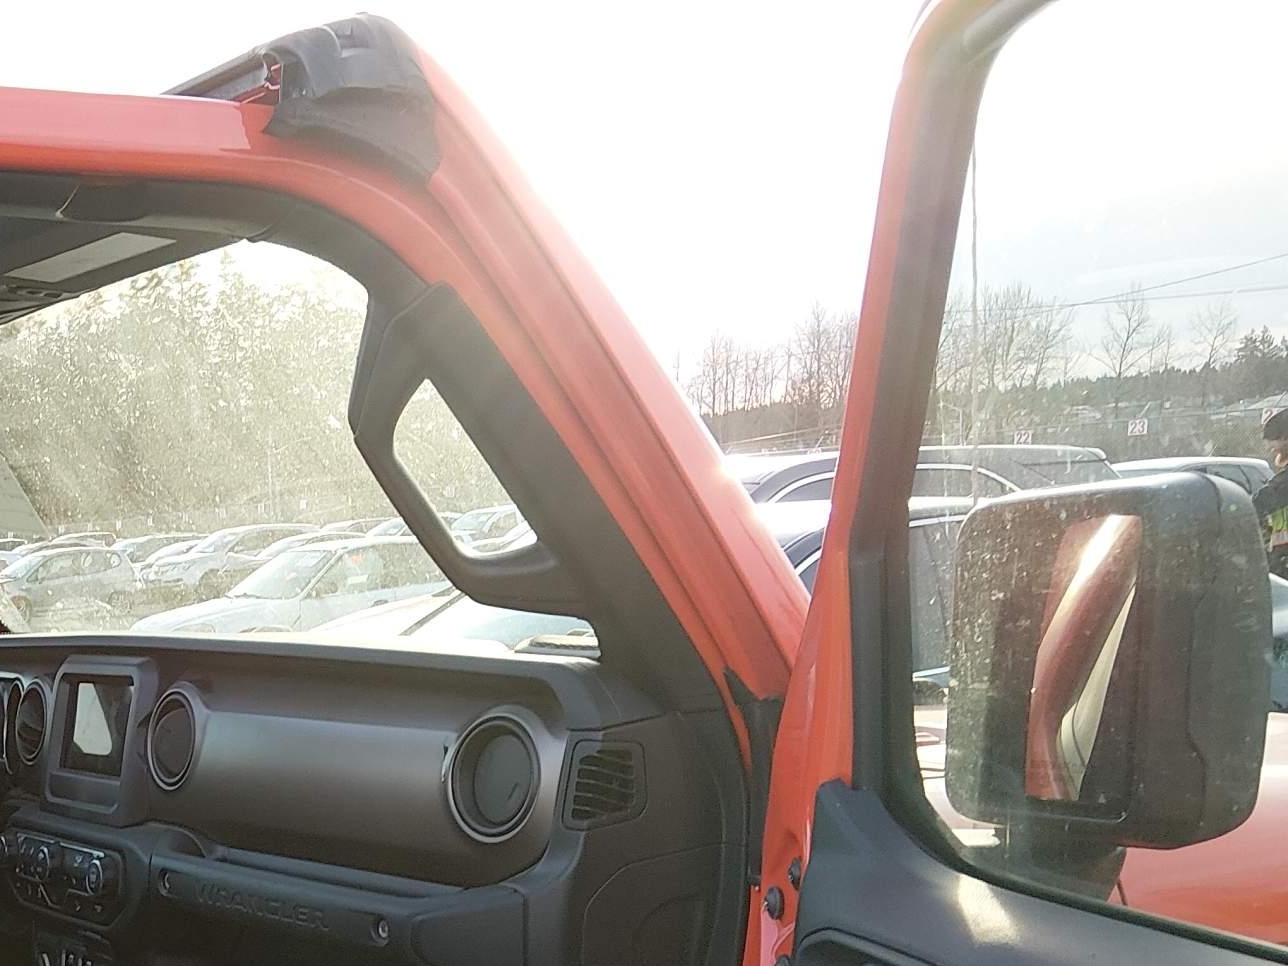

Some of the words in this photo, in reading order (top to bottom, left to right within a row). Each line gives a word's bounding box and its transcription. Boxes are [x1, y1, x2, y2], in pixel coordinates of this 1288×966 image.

[1129, 419, 1146, 434] 23
[1016, 431, 1030, 445] 22
[193, 880, 329, 932] WRANGLER
